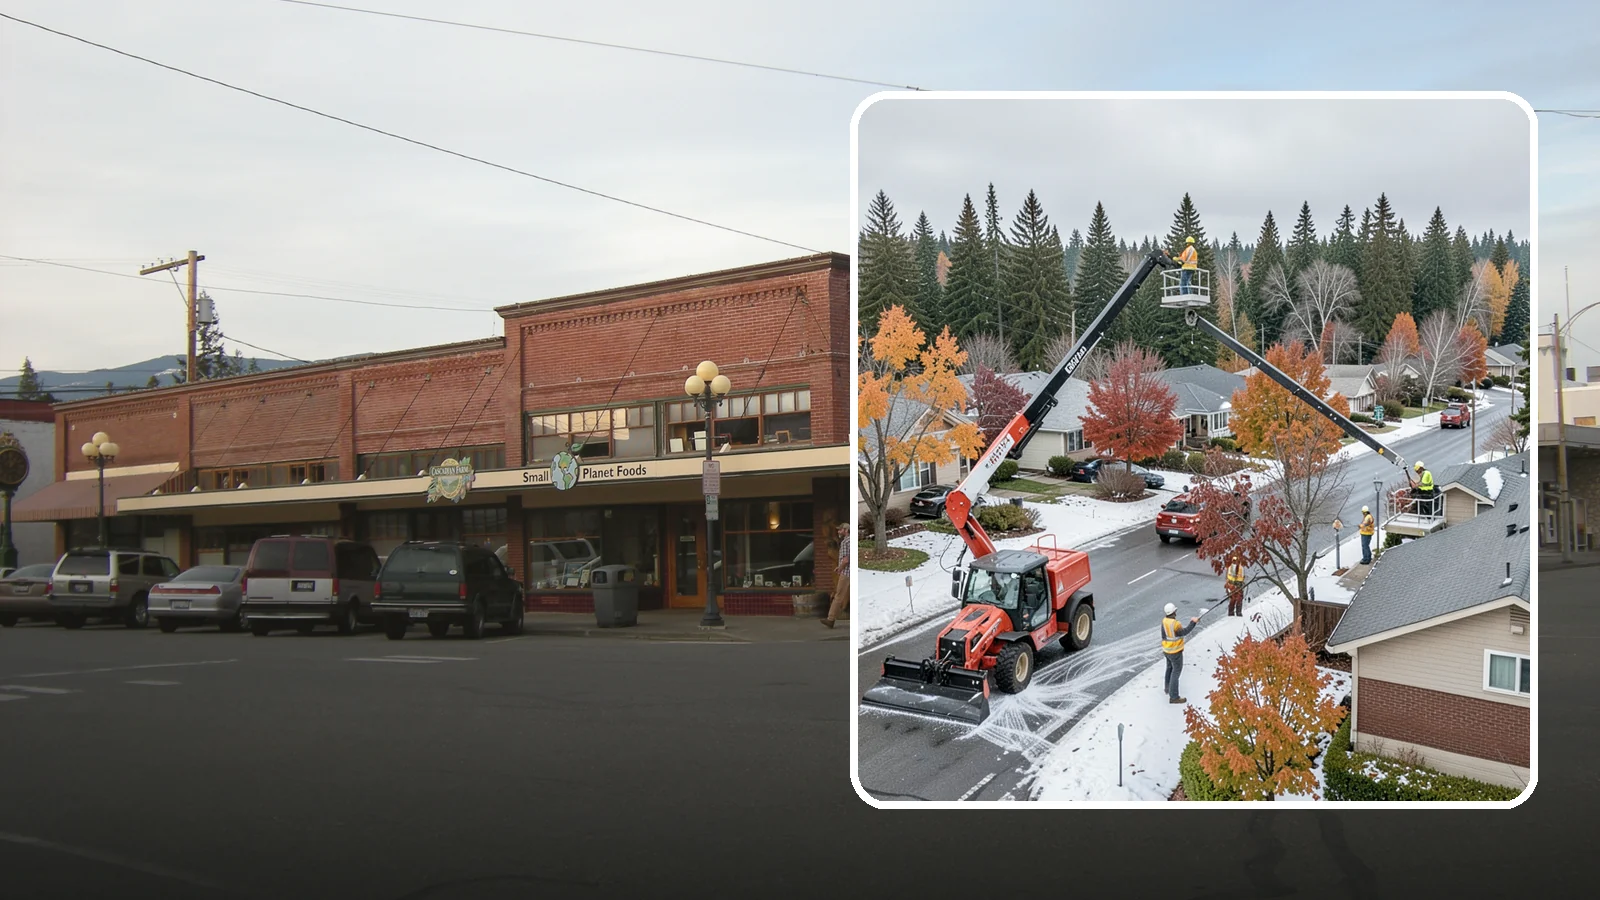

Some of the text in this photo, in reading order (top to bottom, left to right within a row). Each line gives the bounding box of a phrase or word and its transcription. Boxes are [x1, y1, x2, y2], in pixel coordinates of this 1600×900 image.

[523, 464, 647, 483] Small Planet Foods
